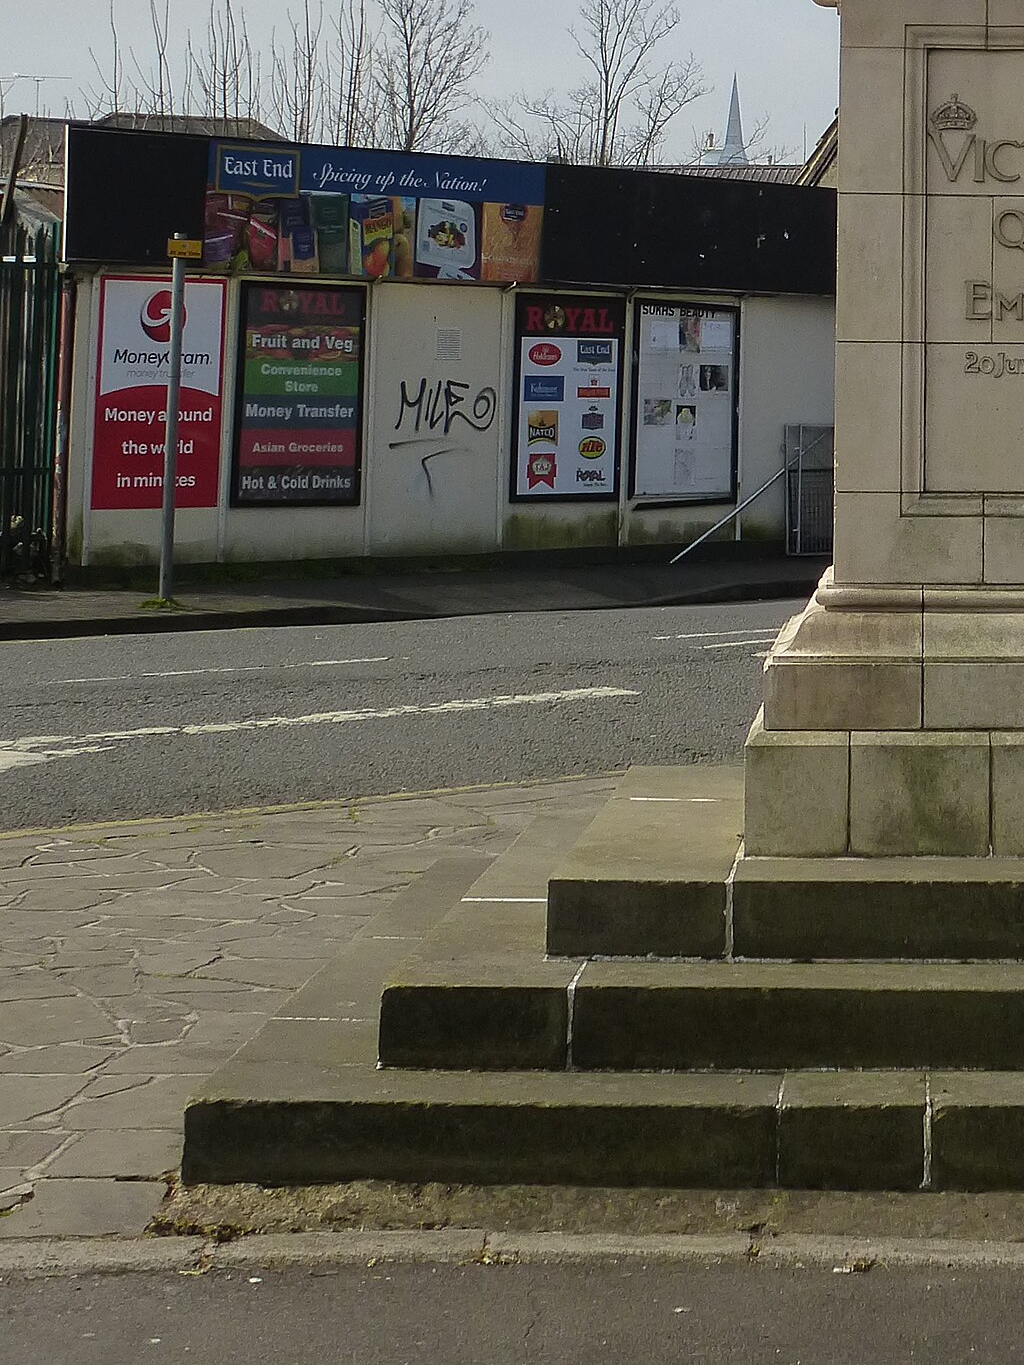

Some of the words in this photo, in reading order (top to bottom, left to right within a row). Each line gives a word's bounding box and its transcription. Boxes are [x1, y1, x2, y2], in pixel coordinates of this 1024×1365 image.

[224, 156, 258, 176] East
[263, 159, 293, 178] End
[313, 162, 372, 189] Spicing
[375, 171, 395, 192] up
[400, 169, 423, 188] the
[424, 171, 487, 192] Nation!
[680, 307, 716, 319] BEAUTY
[252, 334, 288, 348] Fruit
[292, 337, 320, 349] and
[325, 336, 353, 353] Veg
[964, 351, 994, 374] 20
[261, 364, 342, 376] Convenience
[285, 380, 319, 393] Store
[104, 407, 156, 425] Money
[246, 403, 293, 421] Money
[296, 404, 354, 418] Transfer
[529, 427, 555, 438] NATCO
[121, 440, 148, 454] the
[252, 442, 285, 453] Asian
[288, 442, 344, 453] Groceries
[116, 473, 131, 488] in
[242, 476, 264, 489] Hot
[267, 476, 278, 489] &
[281, 476, 309, 489] Cold
[312, 475, 351, 489] Drinks
